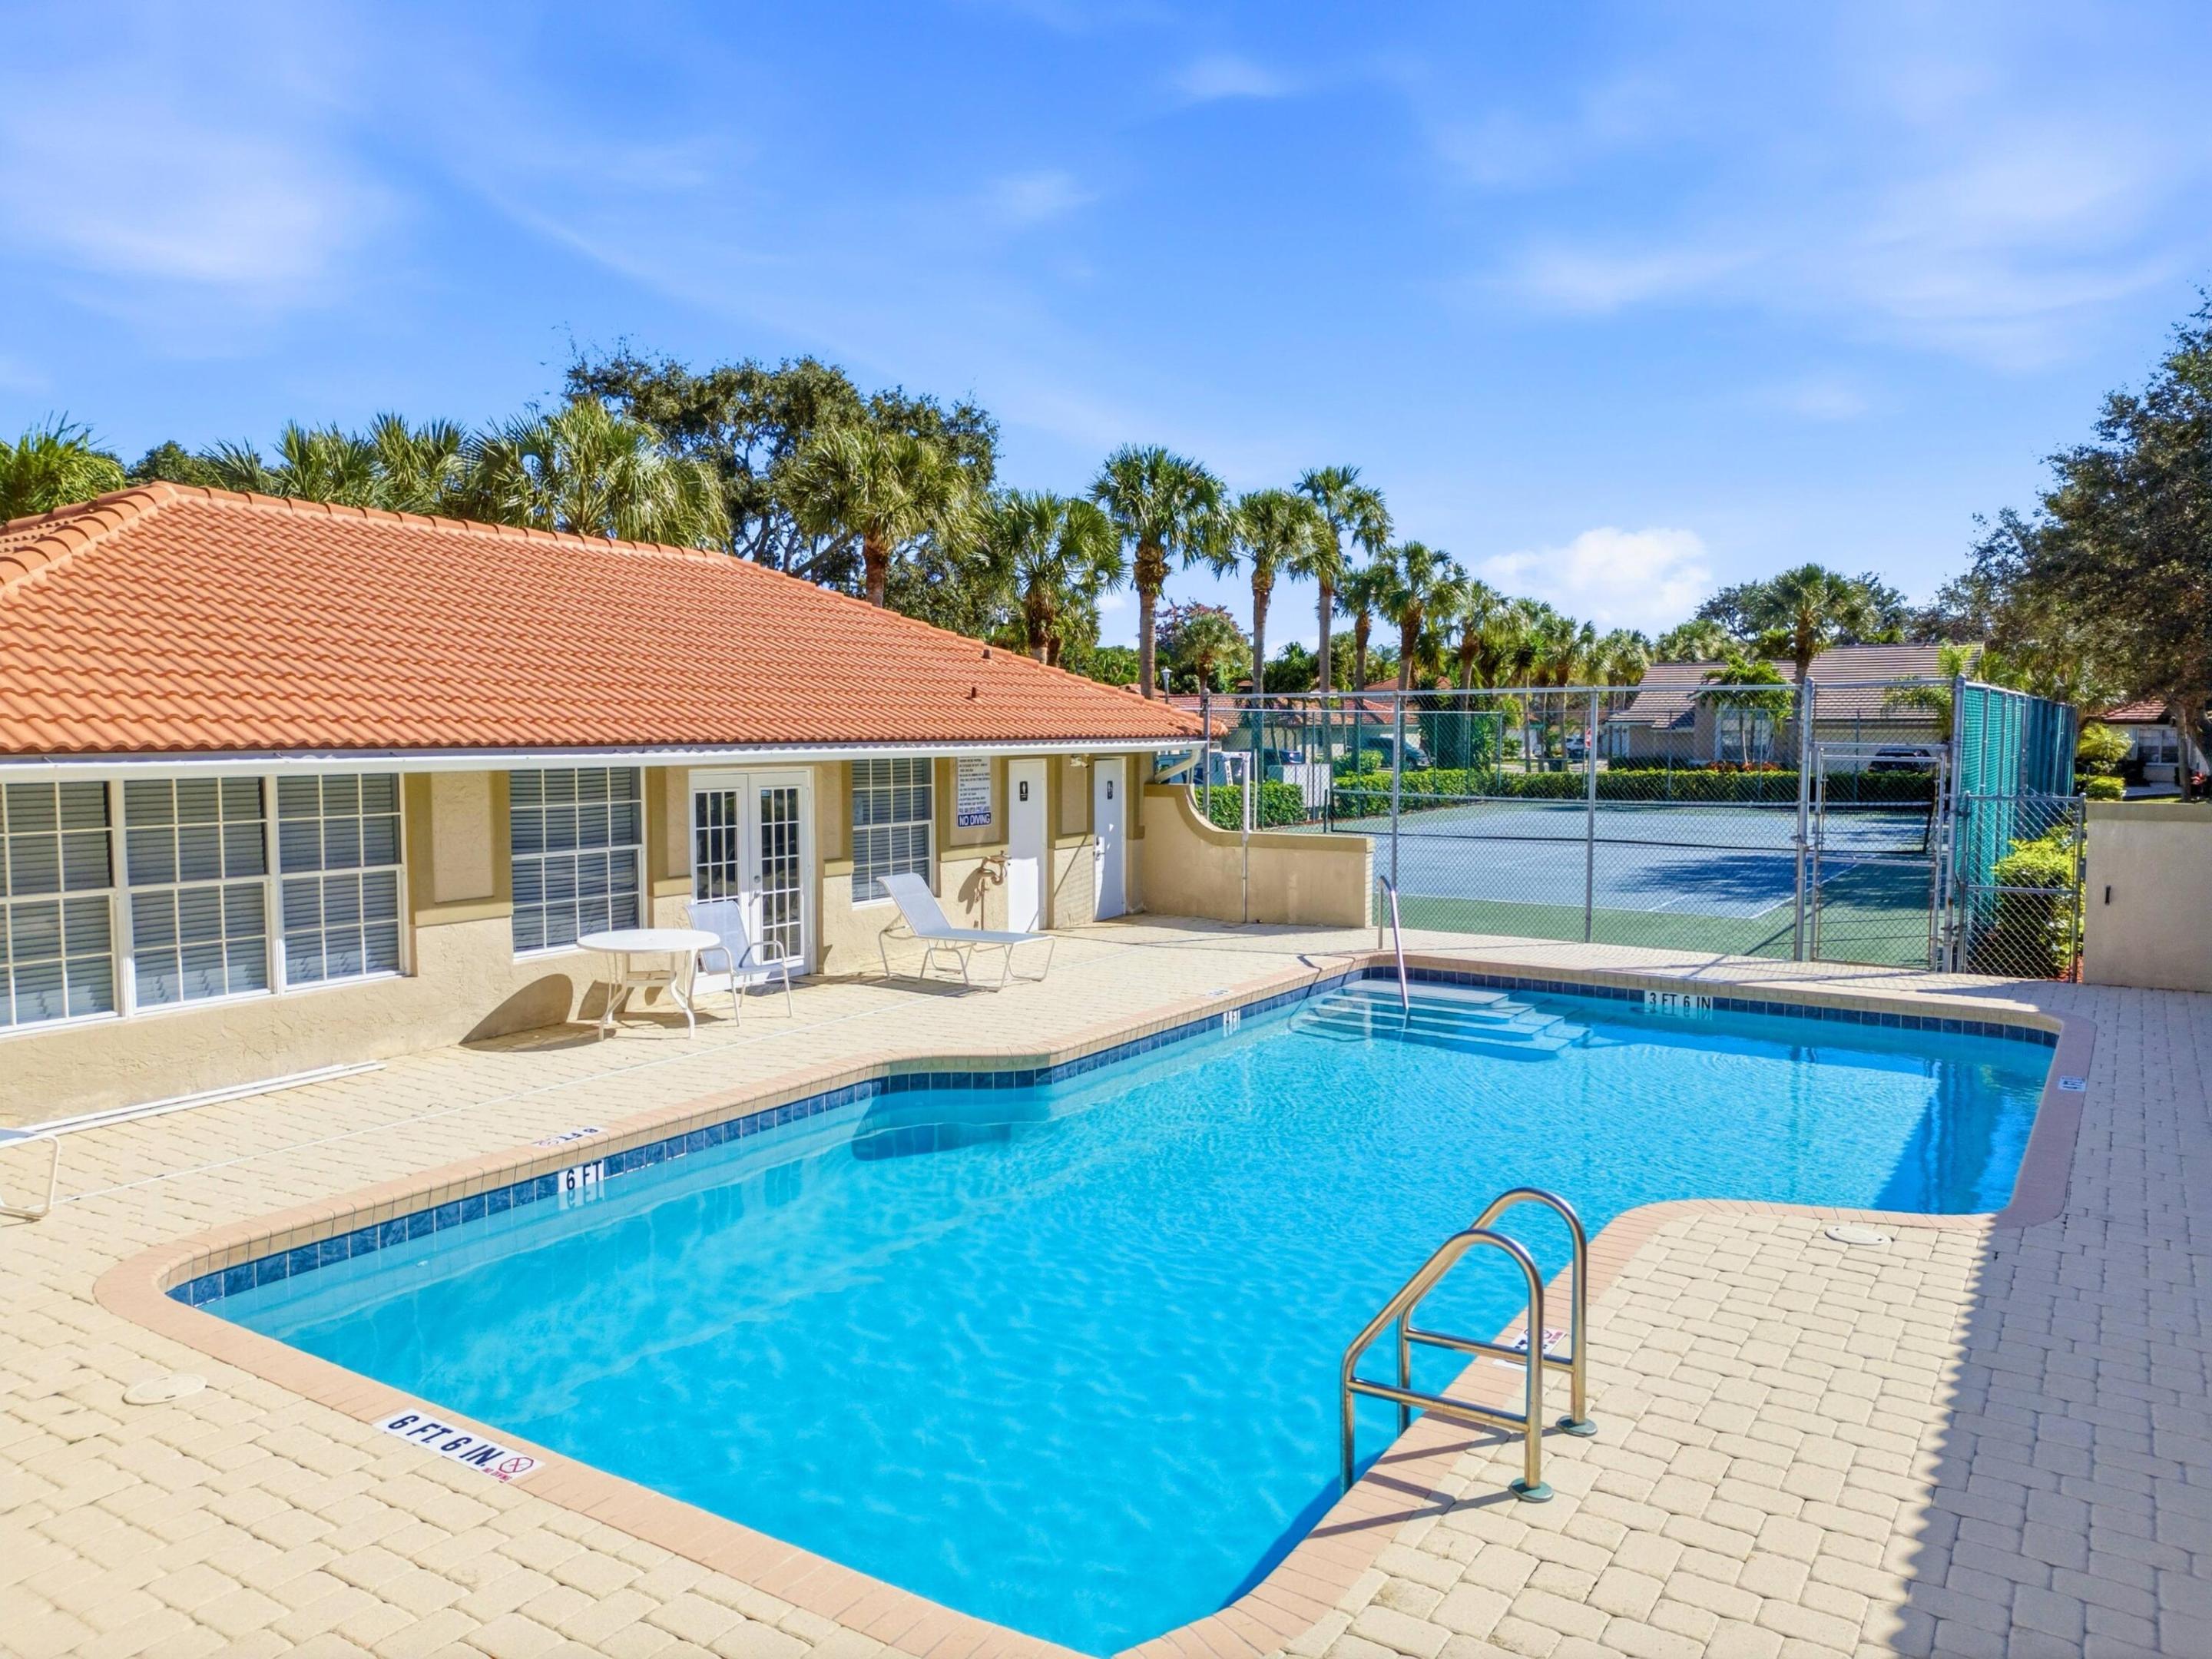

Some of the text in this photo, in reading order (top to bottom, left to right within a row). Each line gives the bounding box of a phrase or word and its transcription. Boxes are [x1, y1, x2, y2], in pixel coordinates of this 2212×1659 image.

[959, 814, 990, 826] NO DIVING
[1650, 992, 1710, 1009] 3 FT 6 IN
[566, 1160, 602, 1190] 6 FT
[388, 1415, 505, 1467] 6 FT. 6 IN.
